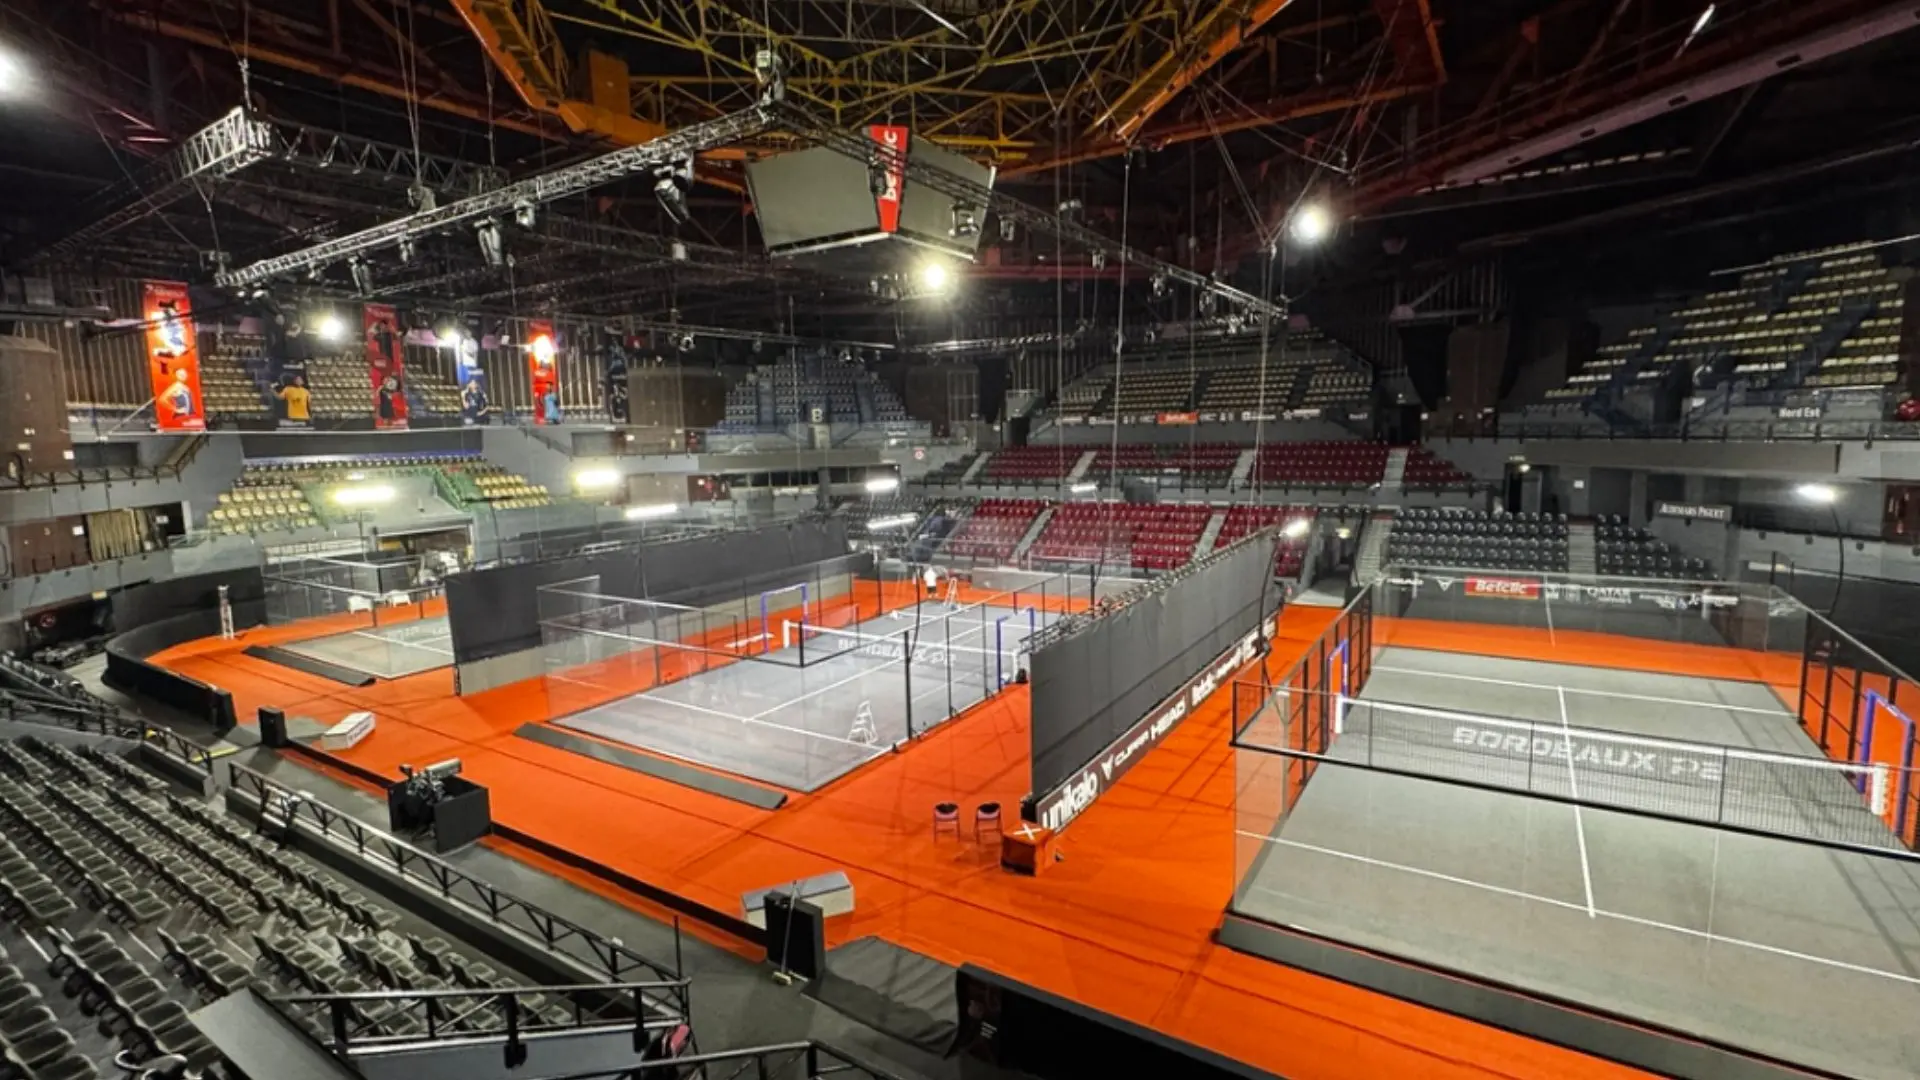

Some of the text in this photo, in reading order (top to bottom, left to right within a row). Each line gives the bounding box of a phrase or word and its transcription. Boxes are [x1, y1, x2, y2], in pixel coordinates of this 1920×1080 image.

[880, 130, 898, 202] belic
[1474, 578, 1527, 594] Betclic
[1452, 726, 1657, 773] BORDEAUX
[1042, 770, 1098, 829] unikalo
